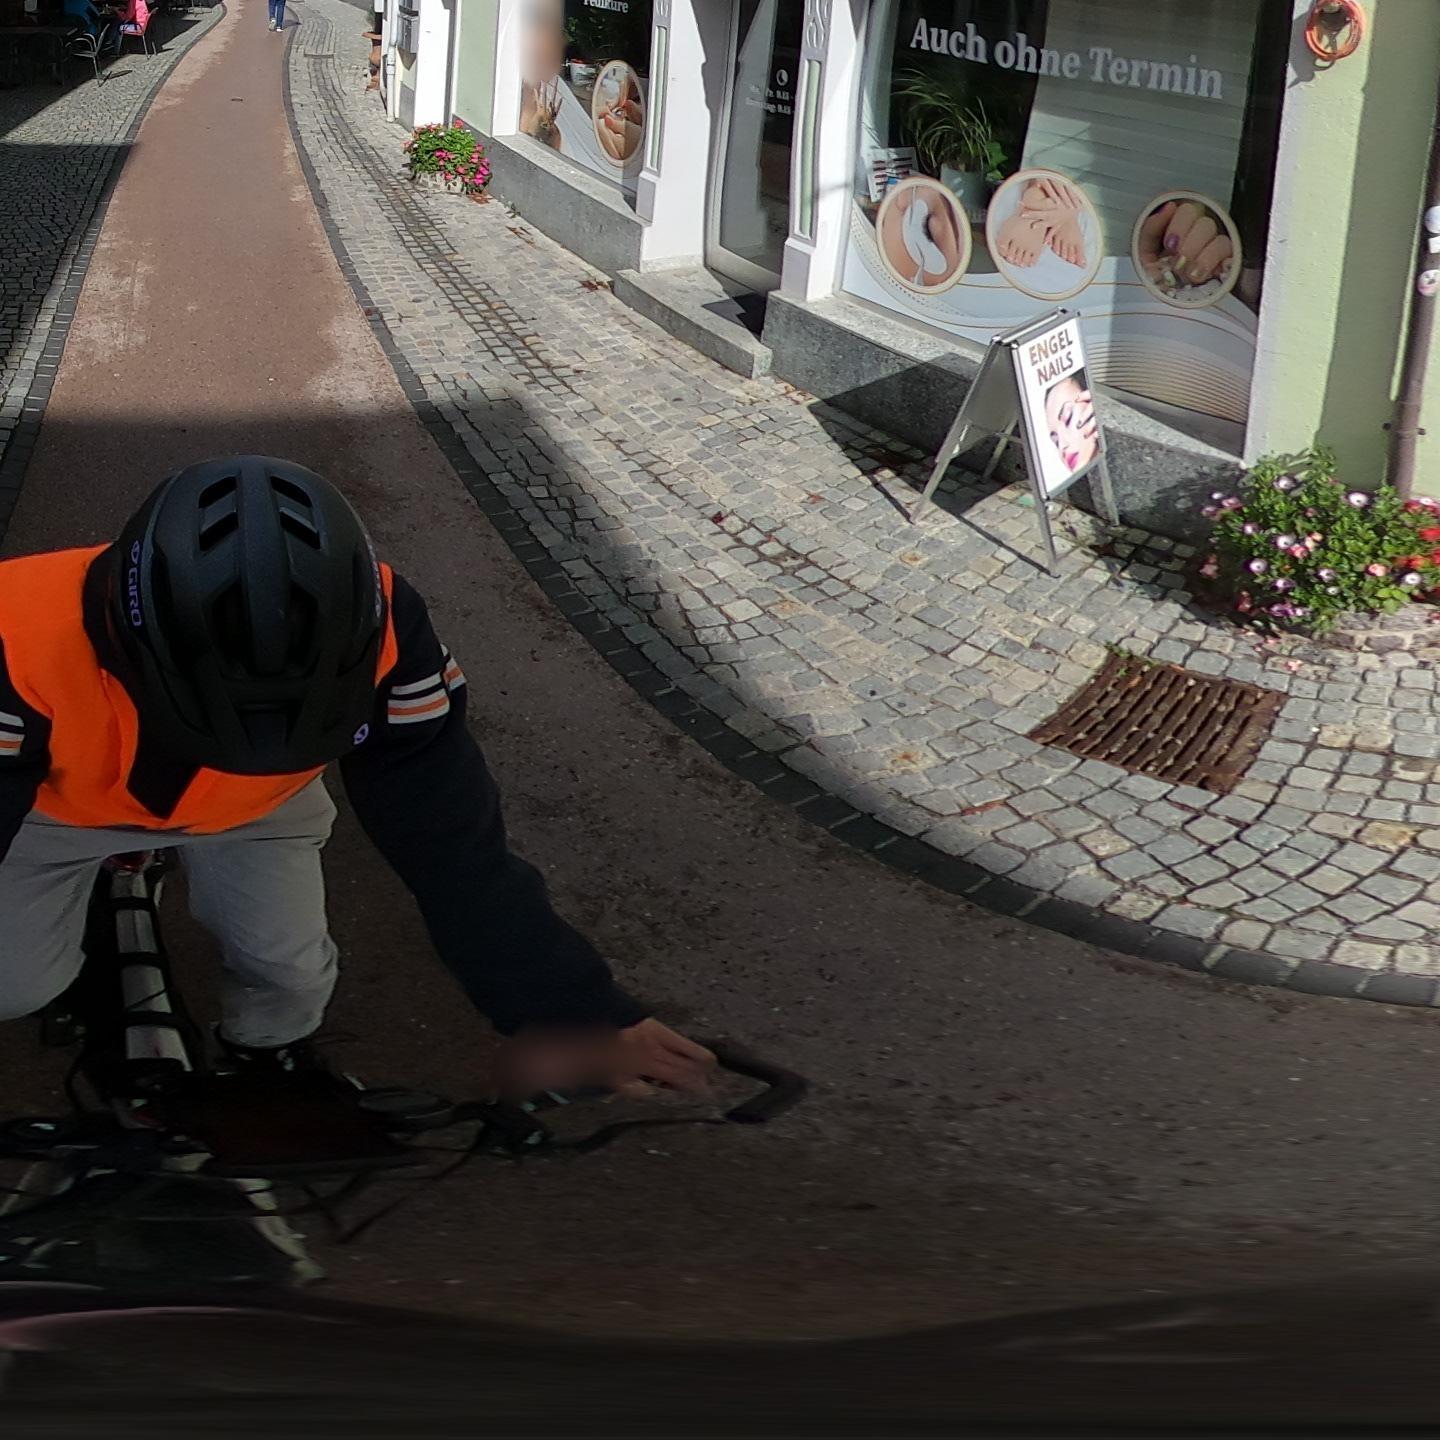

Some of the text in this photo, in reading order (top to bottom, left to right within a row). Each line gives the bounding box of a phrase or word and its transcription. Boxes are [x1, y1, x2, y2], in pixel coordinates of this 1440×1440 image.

[910, 18, 1223, 99] Auch ohne Termin
[1029, 328, 1073, 366] ENGEL
[1037, 351, 1073, 386] NAILS
[128, 567, 142, 626] GIRO
